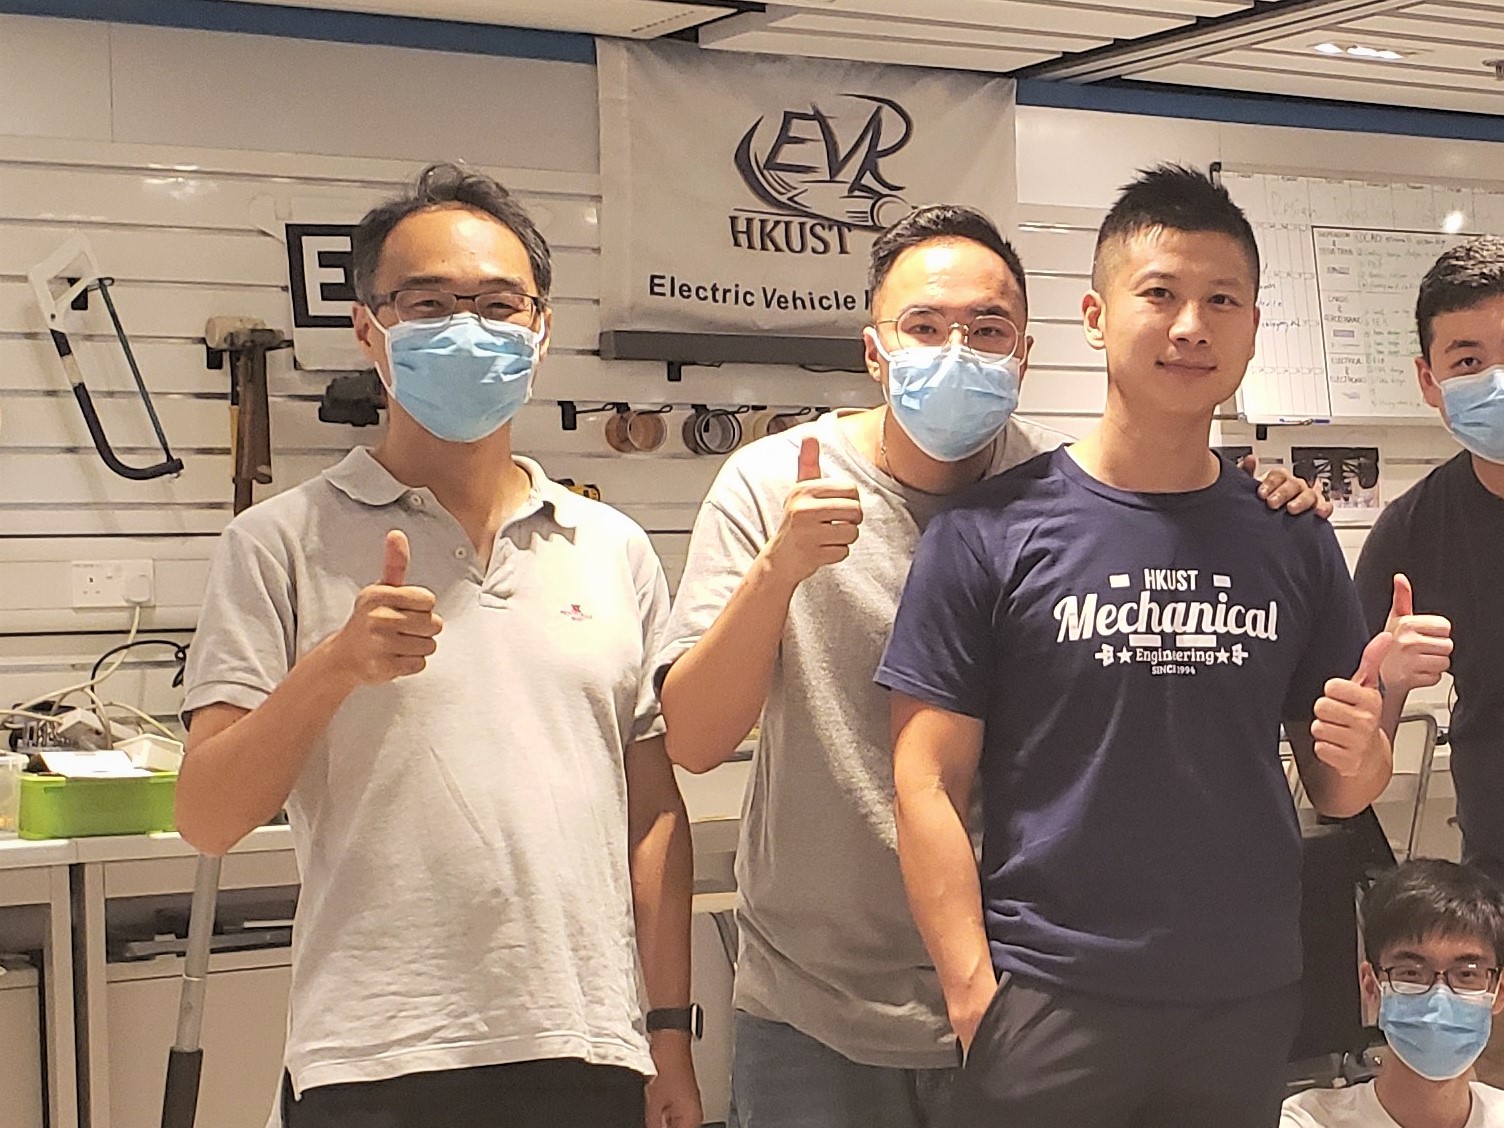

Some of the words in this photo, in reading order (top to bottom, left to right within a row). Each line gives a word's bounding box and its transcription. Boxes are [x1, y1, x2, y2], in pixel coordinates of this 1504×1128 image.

[729, 216, 851, 255] HKUST
[649, 274, 755, 307] Electric
[762, 287, 856, 311] Vehicle
[1143, 568, 1198, 591] HKUST
[1053, 590, 1279, 643] Mechanical
